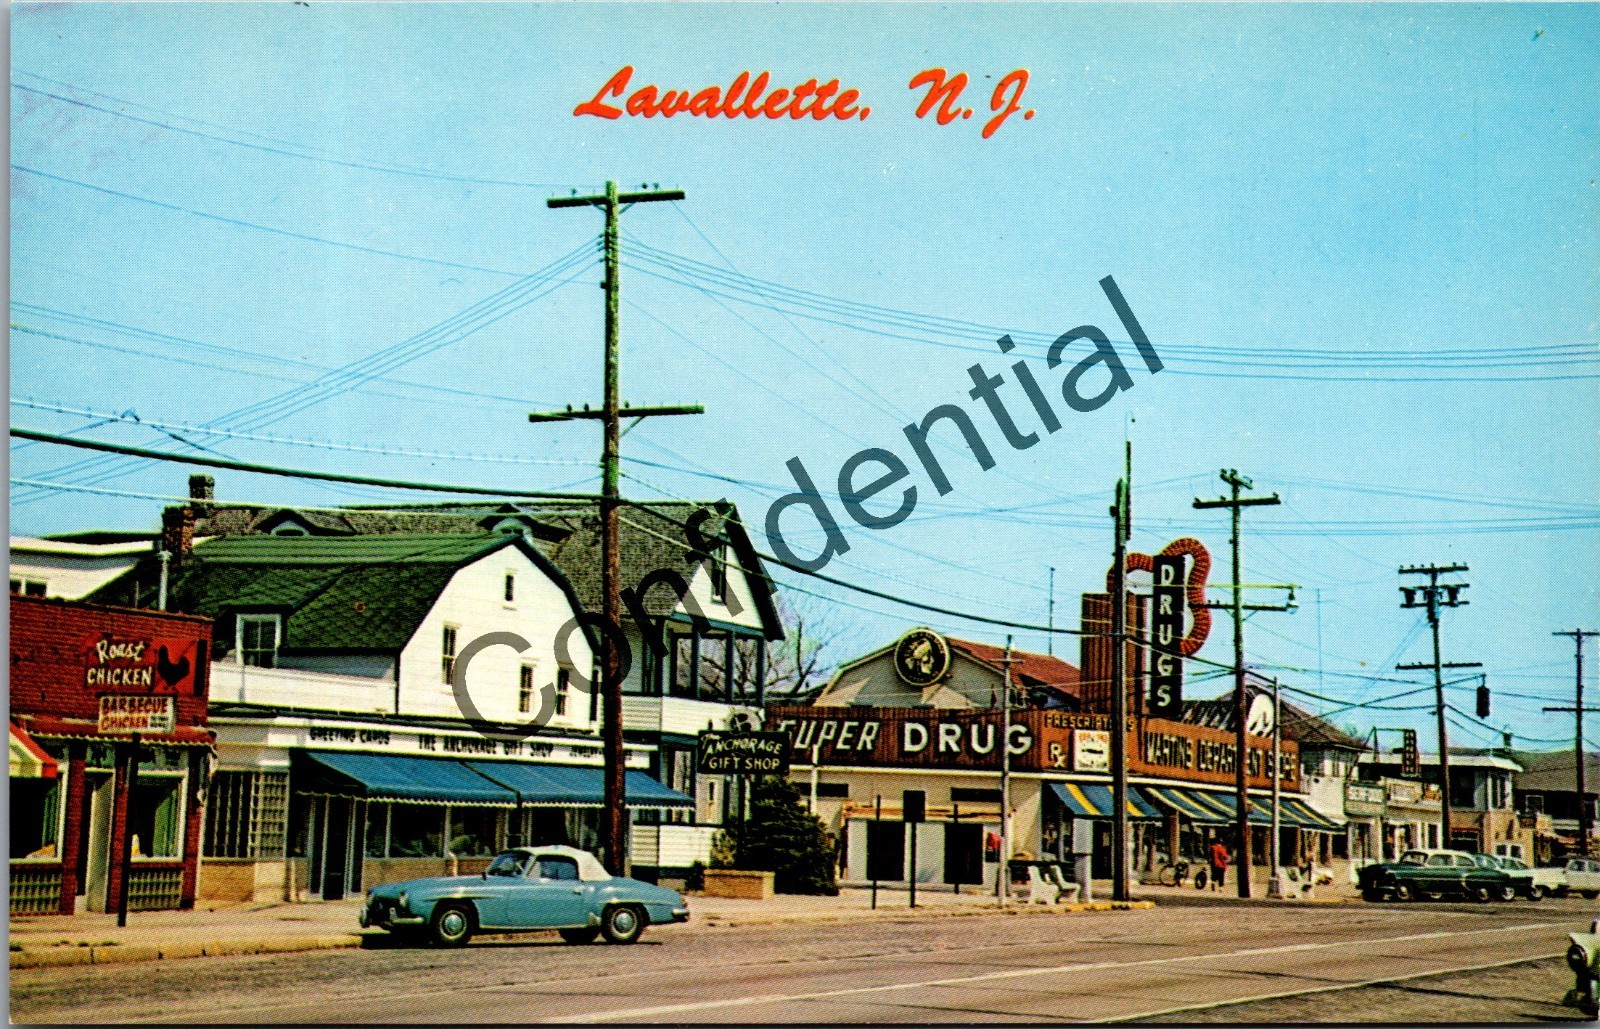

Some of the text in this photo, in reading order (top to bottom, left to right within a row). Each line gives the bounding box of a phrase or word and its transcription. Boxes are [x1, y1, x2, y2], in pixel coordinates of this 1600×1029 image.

[1157, 563, 1175, 708] DRUGS
[96, 640, 145, 664] Roast
[87, 666, 153, 686] CHICKEN
[101, 715, 148, 730] CHICKEN
[1045, 714, 1136, 731] PRESCRIPTIS
[310, 727, 390, 745] GREETING CARDS
[418, 734, 554, 757] THE ANCHORAGE GIFT SHOP
[903, 722, 1032, 755] DRUG
[704, 738, 783, 757] ANCHORAGE
[709, 757, 781, 770] GIFT SHOP
[1198, 739, 1263, 778] DEPARTENT
